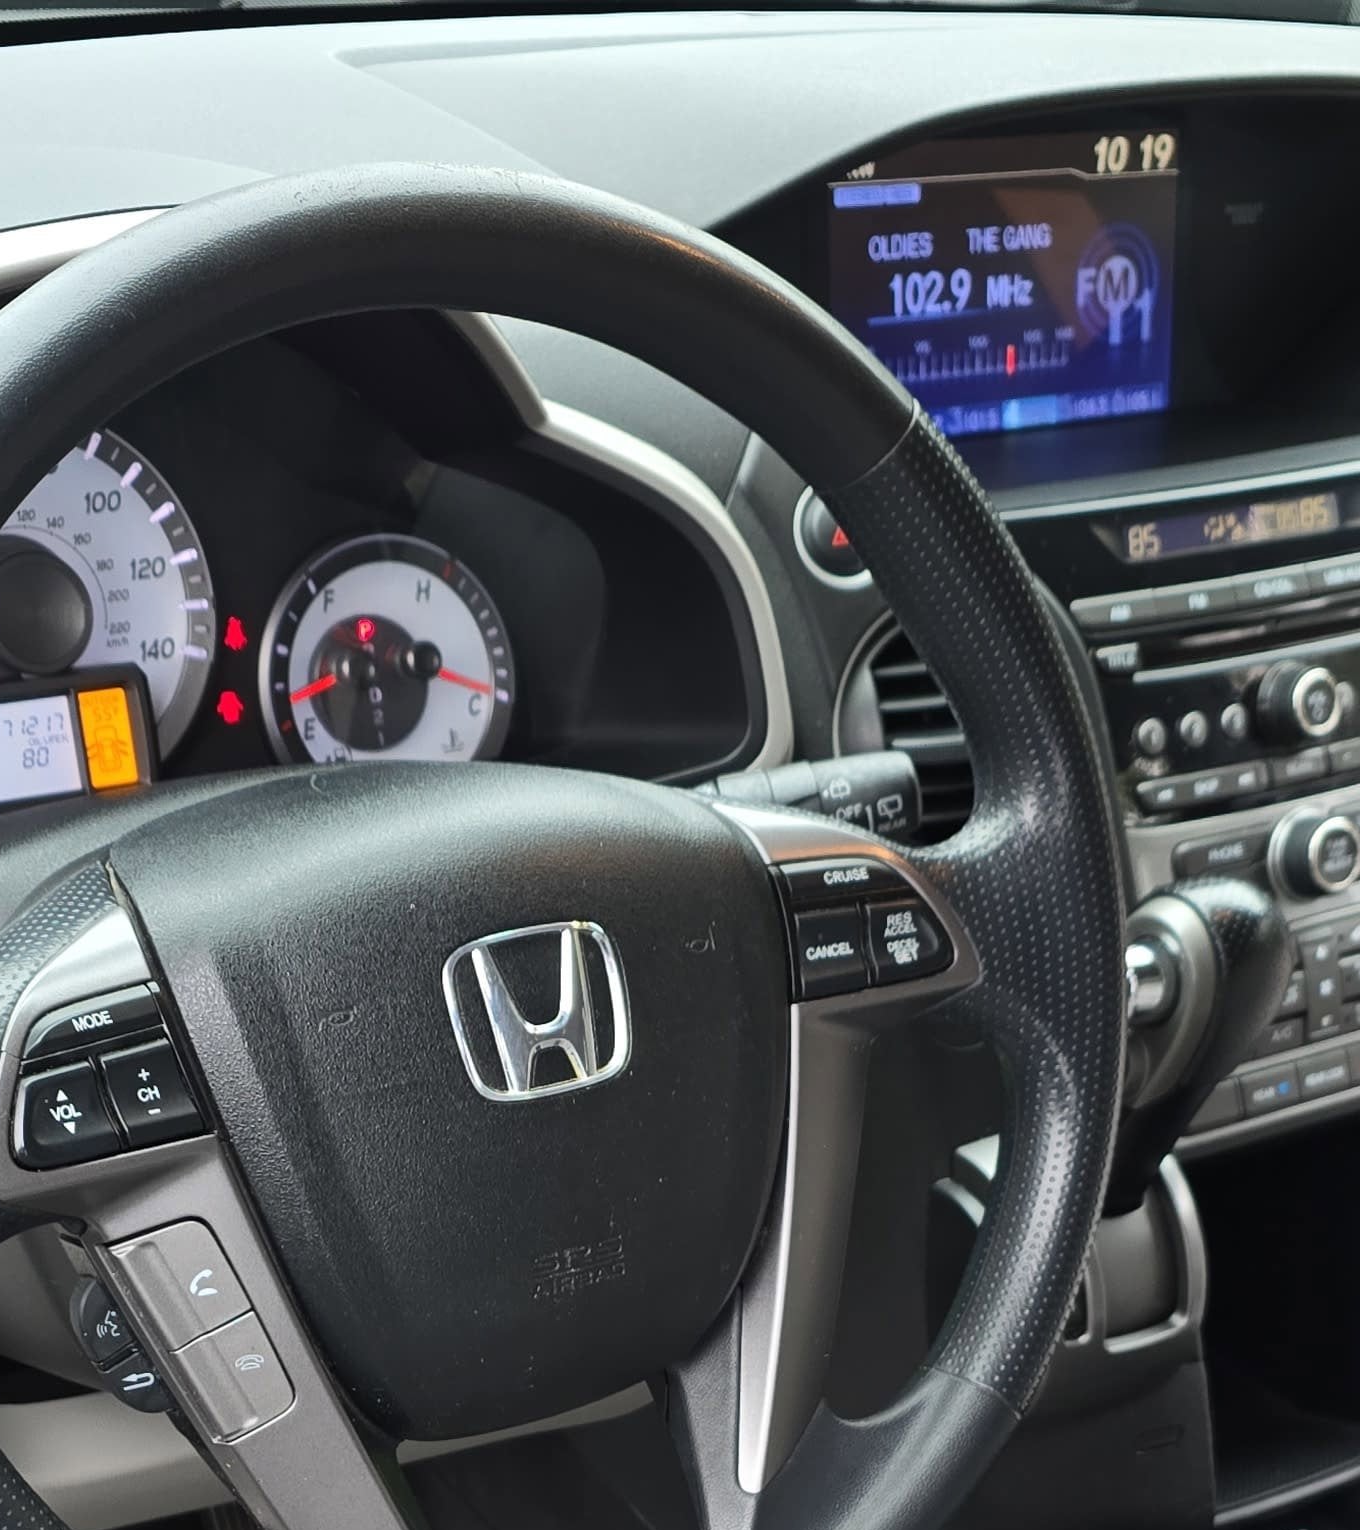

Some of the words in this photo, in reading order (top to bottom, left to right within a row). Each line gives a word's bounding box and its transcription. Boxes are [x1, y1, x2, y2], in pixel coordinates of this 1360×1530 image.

[867, 231, 934, 262] OLDIES
[965, 226, 1001, 254] THE
[1002, 222, 1054, 251] GANG
[889, 267, 973, 318] 102.9
[986, 272, 1034, 308] MHz
[85, 490, 122, 514] 100
[17, 509, 36, 522] 120
[46, 516, 65, 529] 140
[73, 533, 92, 546] 160
[96, 558, 114, 572] 180
[131, 556, 166, 581] 120
[416, 579, 431, 603] H
[323, 590, 334, 613] F
[109, 620, 131, 635] 220
[357, 618, 375, 642] P
[140, 637, 176, 663] 140
[468, 693, 481, 716] C
[304, 718, 316, 741] E
[22, 747, 50, 769] 80
[824, 867, 869, 885] CRUISE
[886, 912, 913, 926] RES
[884, 924, 917, 938] ACCEL
[806, 941, 854, 961] CANCEL
[887, 941, 920, 954] DECEL
[894, 949, 920, 964] SET
[72, 1010, 113, 1032] MODE
[137, 1086, 160, 1101] CH
[49, 1102, 82, 1120] VOL
